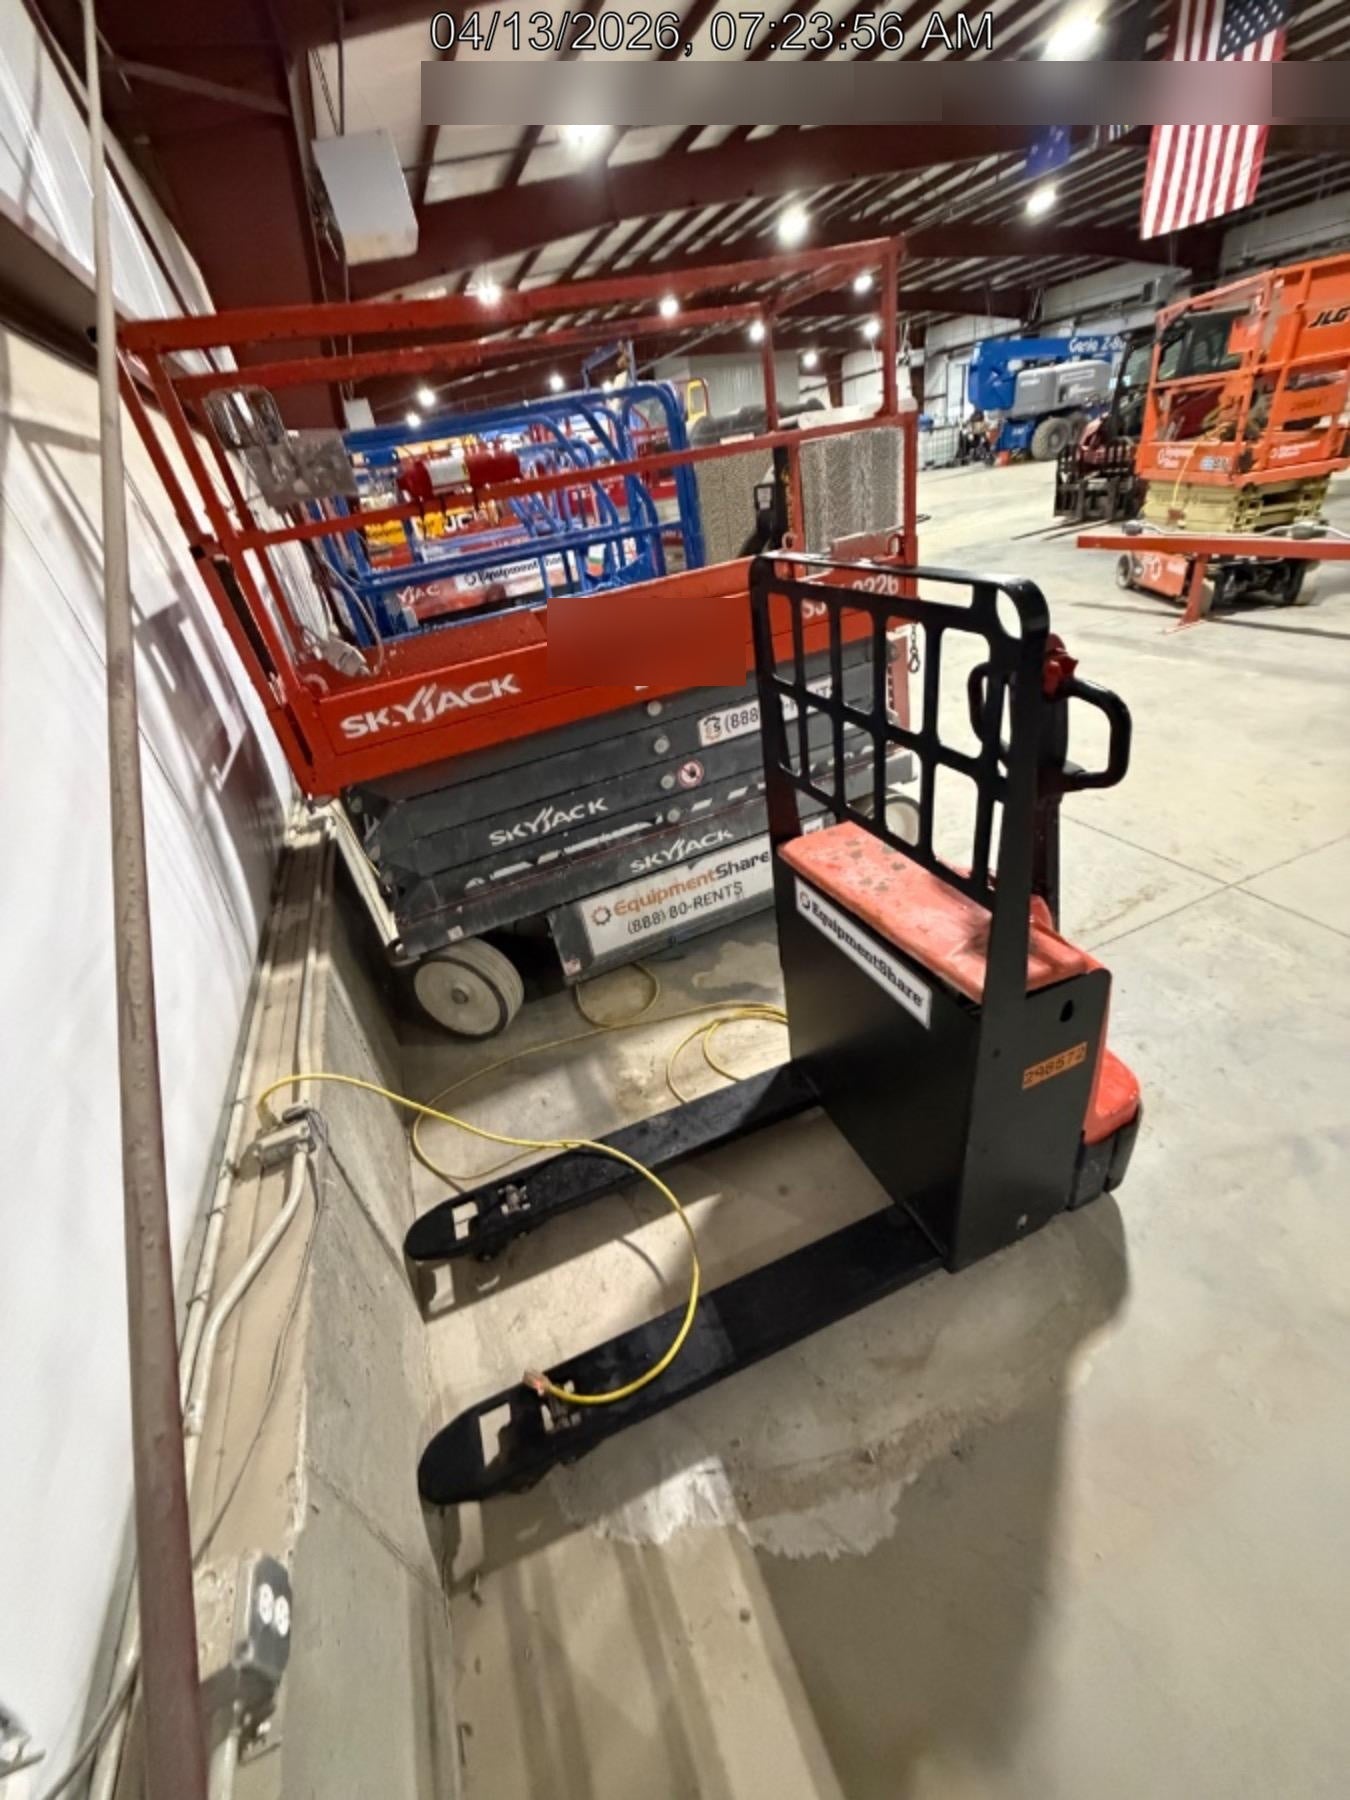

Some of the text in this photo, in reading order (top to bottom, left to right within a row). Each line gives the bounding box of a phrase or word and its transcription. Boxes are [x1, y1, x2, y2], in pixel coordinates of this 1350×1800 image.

[340, 674, 521, 739] SKYJACK
[489, 797, 608, 847] SKYJACK
[629, 828, 734, 874] SKYJACK
[613, 850, 771, 917] EquipmentShare
[627, 881, 744, 935] (888) 80-RENTS
[811, 901, 925, 1008] EquipmentShare
